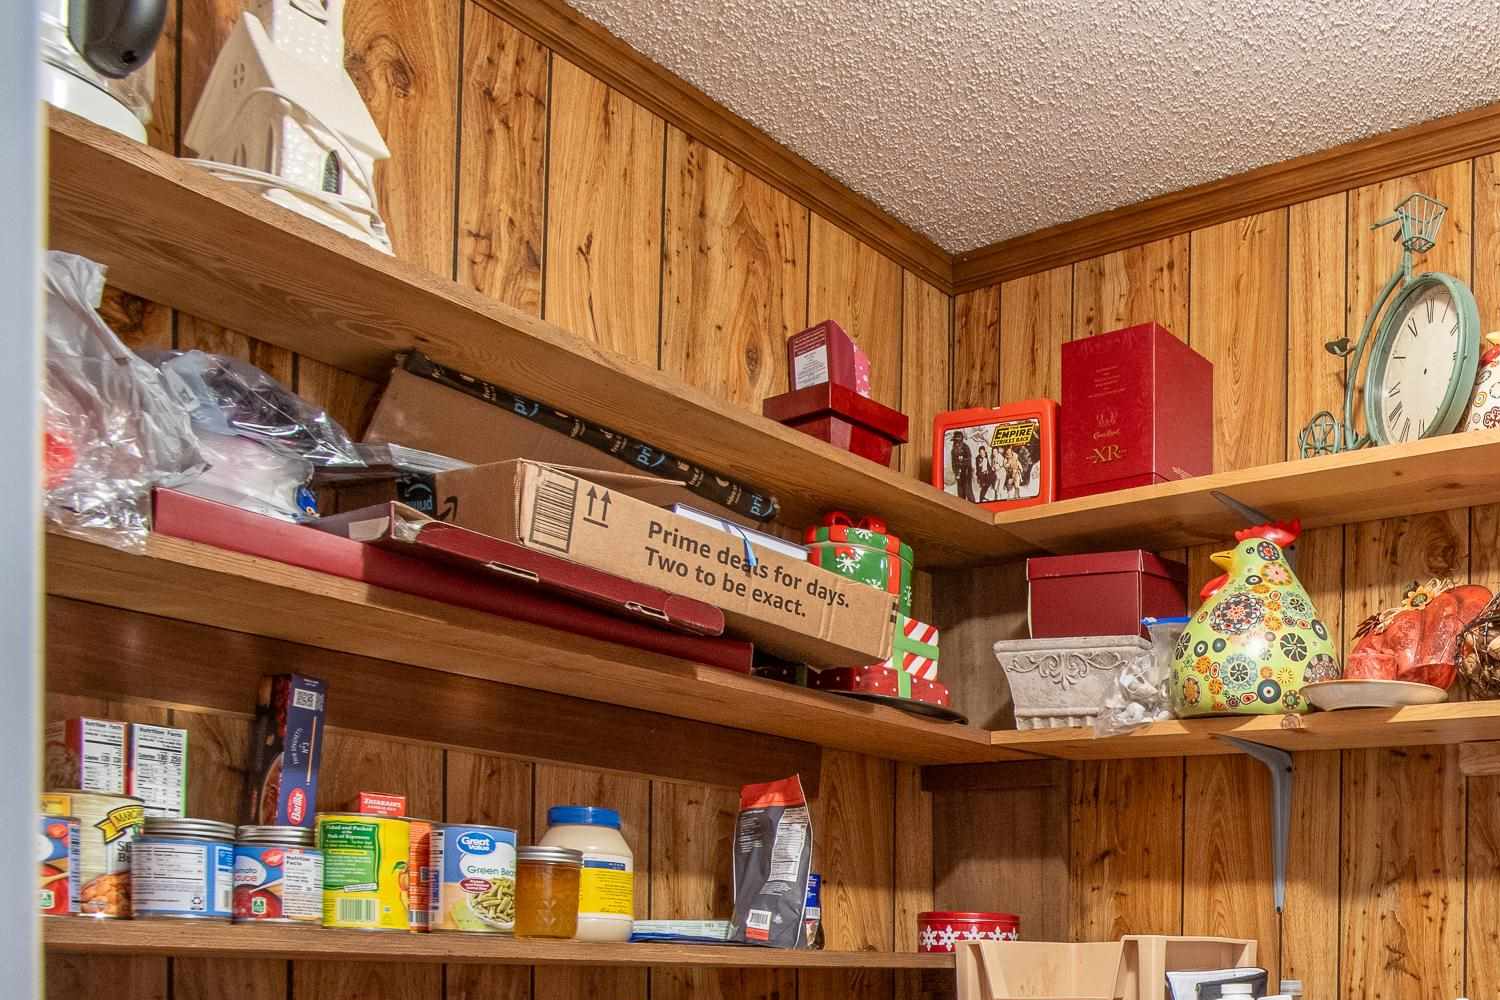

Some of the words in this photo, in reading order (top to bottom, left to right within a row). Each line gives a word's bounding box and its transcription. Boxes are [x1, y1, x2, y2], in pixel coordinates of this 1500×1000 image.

[995, 428, 1032, 440] EMPIRE
[1092, 443, 1121, 463] XR
[647, 520, 711, 559] Prime
[773, 566, 802, 590] for
[806, 579, 850, 608] days.
[644, 547, 688, 578] Two
[695, 565, 716, 587] to
[723, 573, 747, 597] be
[752, 588, 806, 618] exact.
[290, 792, 303, 821] Barilla
[461, 836, 490, 847] Great
[467, 843, 490, 851] Value
[467, 866, 499, 876] Green
